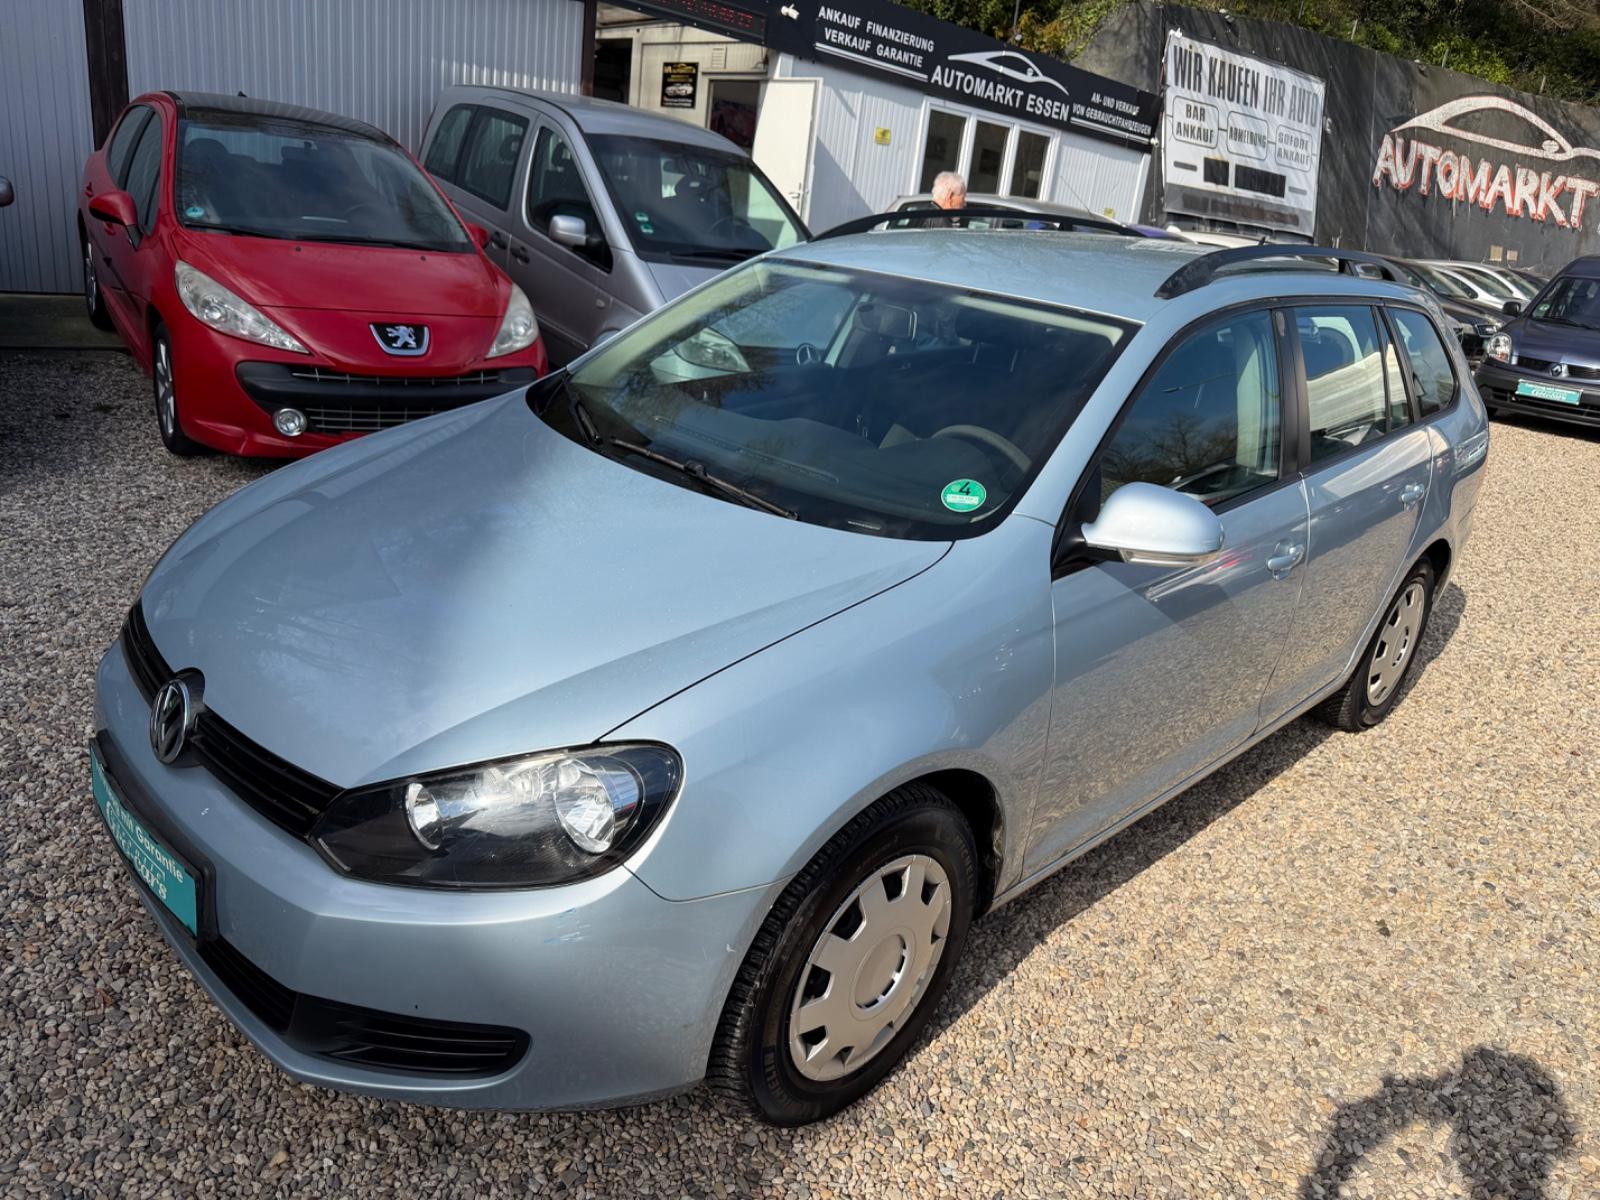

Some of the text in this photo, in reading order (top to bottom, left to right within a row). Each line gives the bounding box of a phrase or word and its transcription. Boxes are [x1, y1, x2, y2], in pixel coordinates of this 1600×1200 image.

[819, 6, 935, 52] ANKAUF FINANZIERUNG
[825, 28, 924, 67] VERKAUF GARANTIE
[930, 65, 1070, 121] AUTOMARKT ESSEN
[1173, 45, 1203, 92] WIR
[1208, 56, 1260, 109] KAUFEN
[1263, 75, 1286, 116] IHR
[1288, 85, 1319, 127] AUTO
[1072, 102, 1152, 135] VON GEBRAUCHTFAHRZEUGEN
[1102, 96, 1115, 109] UND
[1115, 100, 1140, 115] VERKAUF
[1185, 104, 1206, 122] BAR
[1176, 122, 1214, 144] ANKAUF
[1277, 147, 1310, 166] ANKAUF
[1372, 134, 1600, 230] AUTOMARKT
[959, 481, 971, 495] 4
[135, 826, 183, 883] Garantie
